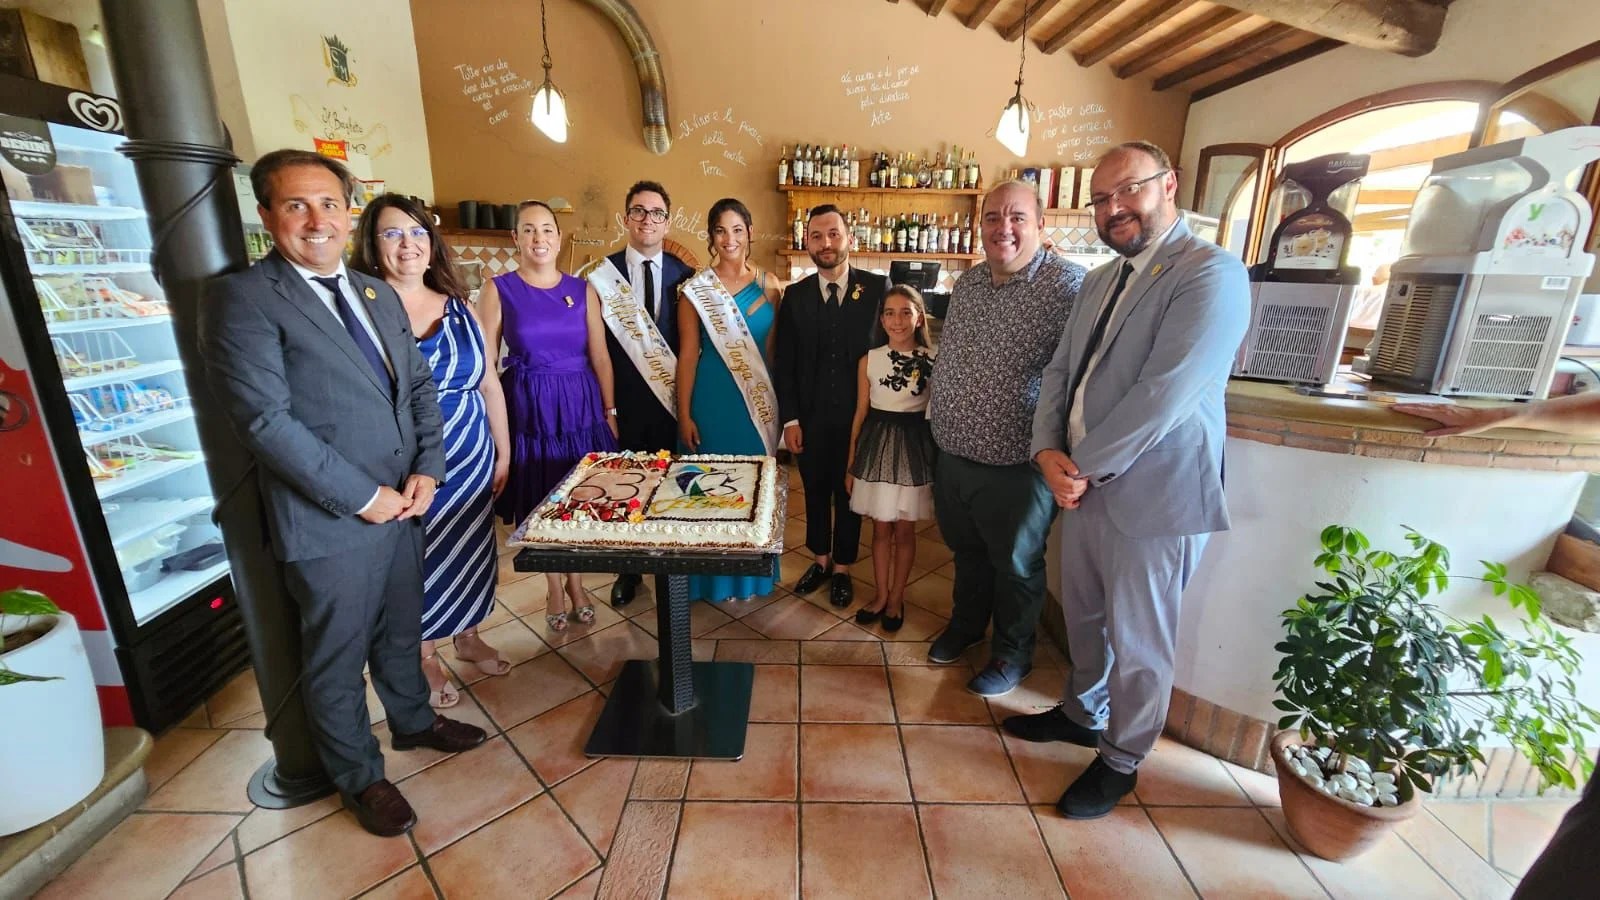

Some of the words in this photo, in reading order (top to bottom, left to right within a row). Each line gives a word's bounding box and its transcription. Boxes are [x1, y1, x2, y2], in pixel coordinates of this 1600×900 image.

[725, 340, 753, 382] Targa
[750, 381, 775, 425] Cecina
[568, 471, 646, 502] 63
